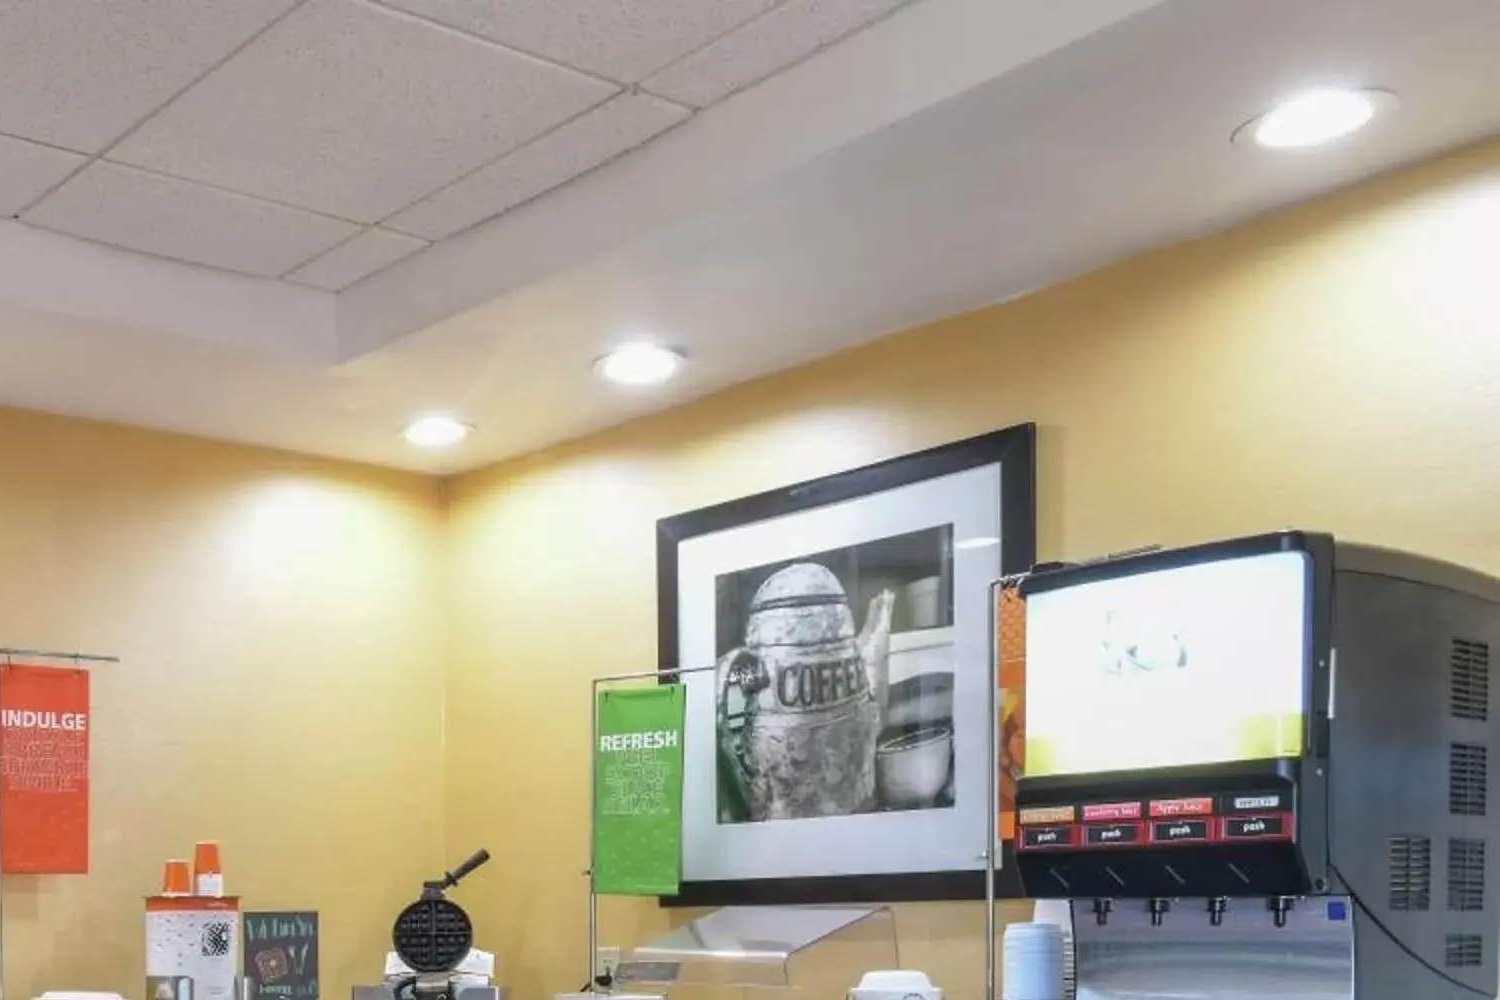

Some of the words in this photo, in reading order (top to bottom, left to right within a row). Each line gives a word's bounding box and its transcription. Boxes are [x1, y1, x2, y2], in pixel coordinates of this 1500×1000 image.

[1, 708, 86, 729] INDULGE
[600, 730, 678, 752] REFRESH
[1169, 825, 1191, 836] push
[1243, 820, 1266, 832] push
[1037, 832, 1057, 842] push
